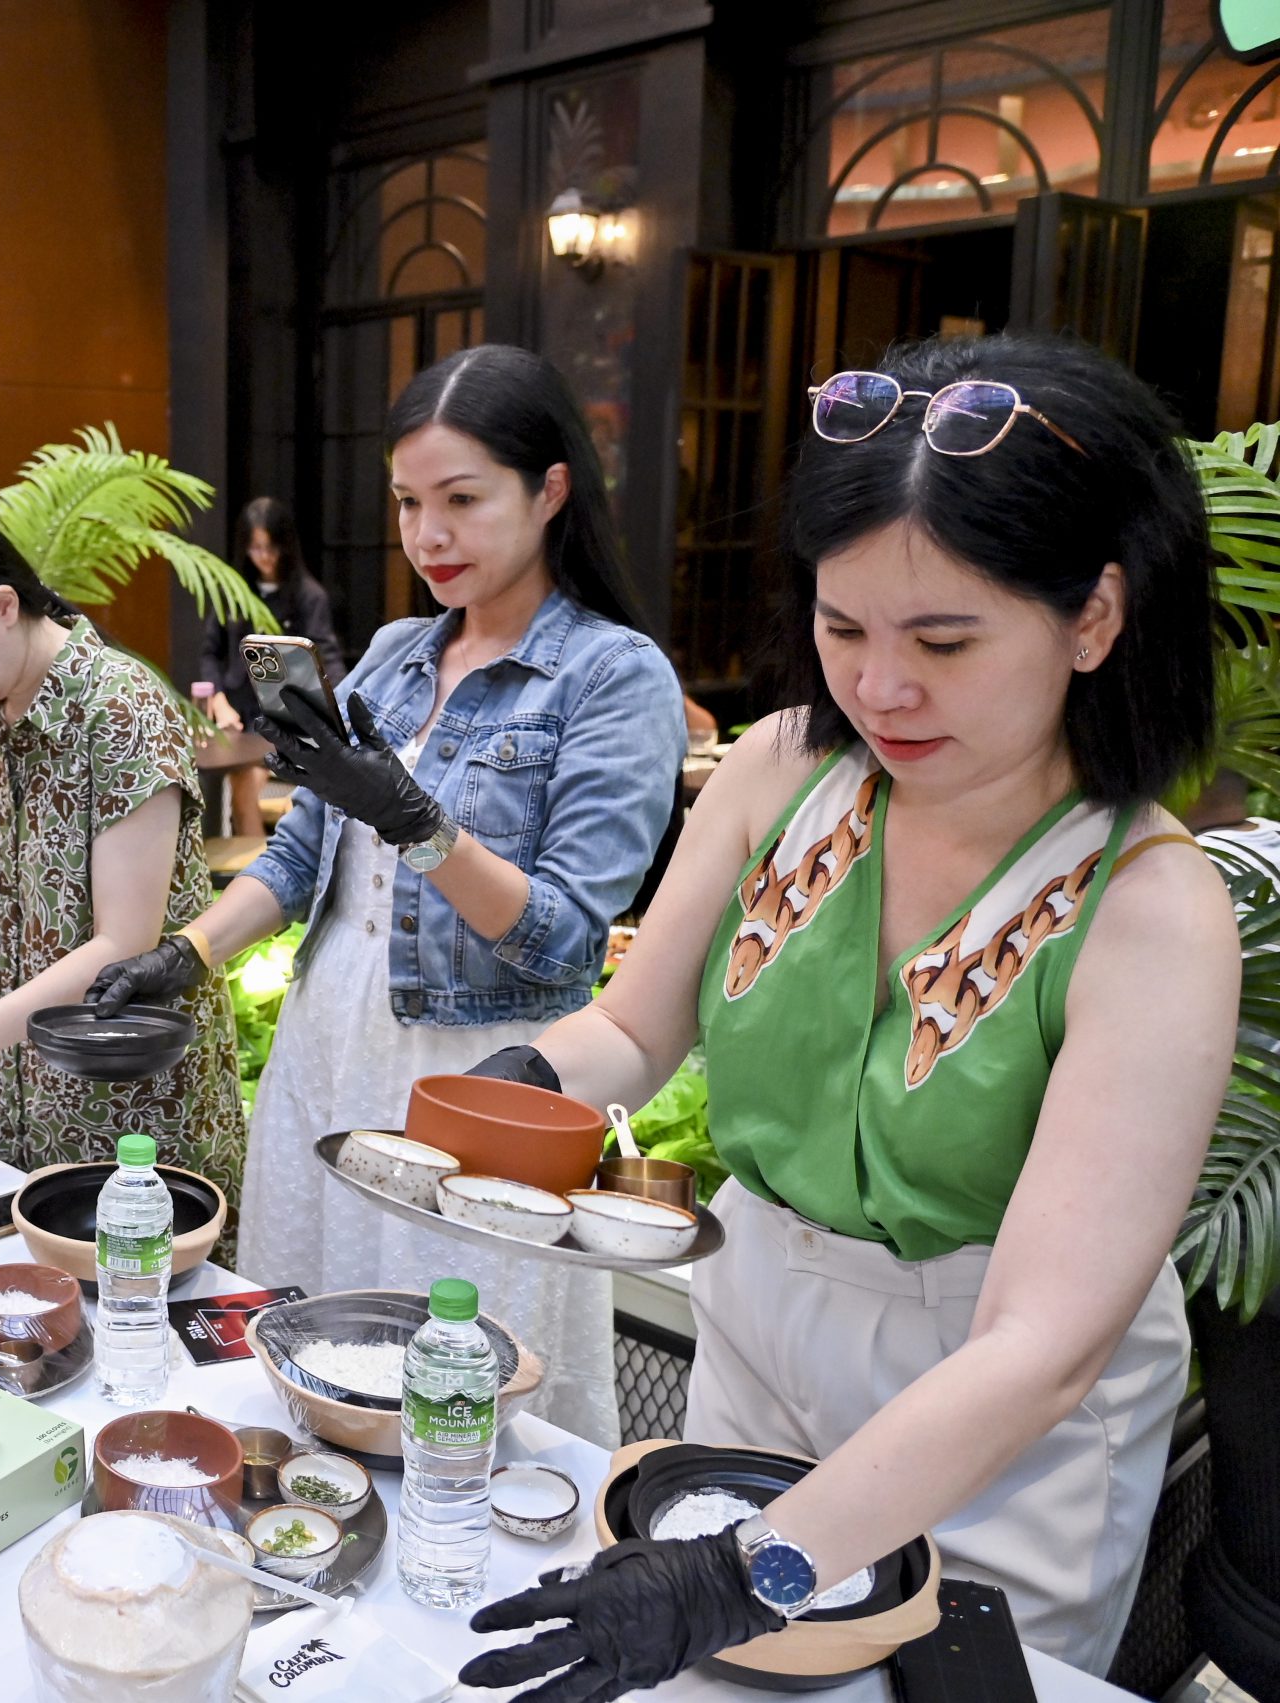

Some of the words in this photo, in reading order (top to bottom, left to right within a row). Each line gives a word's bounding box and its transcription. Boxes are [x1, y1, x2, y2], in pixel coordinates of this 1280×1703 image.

[447, 1405, 473, 1418] ICE
[429, 1414, 487, 1429] MOUNTAIN
[54, 1477, 80, 1497] GREENZ
[268, 1655, 334, 1688] COLOMBO
